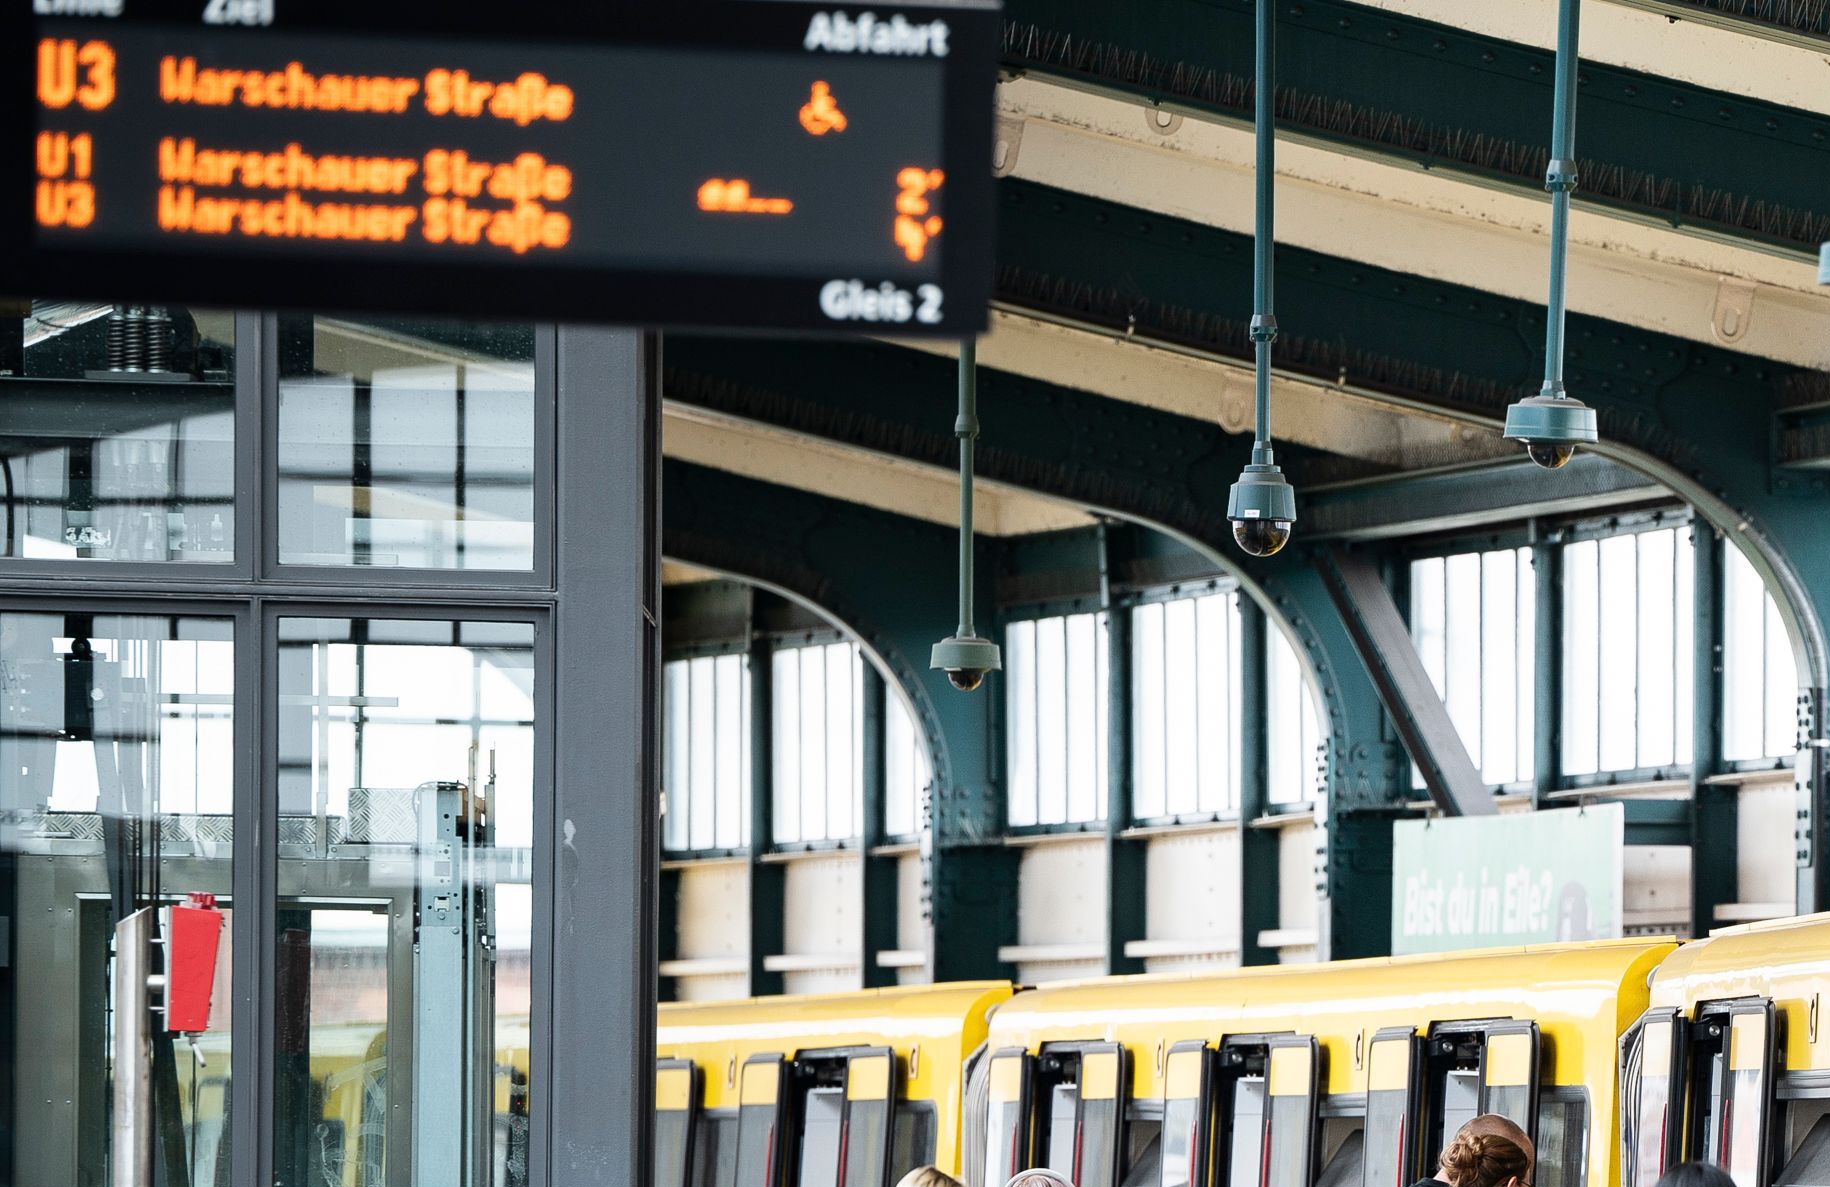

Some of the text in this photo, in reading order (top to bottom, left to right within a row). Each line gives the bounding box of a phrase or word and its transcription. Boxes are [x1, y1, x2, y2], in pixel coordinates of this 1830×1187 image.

[805, 12, 947, 56] Abfahrt
[38, 39, 115, 110] U3
[160, 56, 573, 126] Warschauer Straße
[36, 132, 92, 179] U1
[158, 137, 572, 203] Warschauer Straße
[36, 179, 95, 227] U3
[158, 185, 572, 254] Warschauer Straße
[820, 280, 943, 323] Gleis 2
[1403, 864, 1553, 936] Bist du in Eile?
